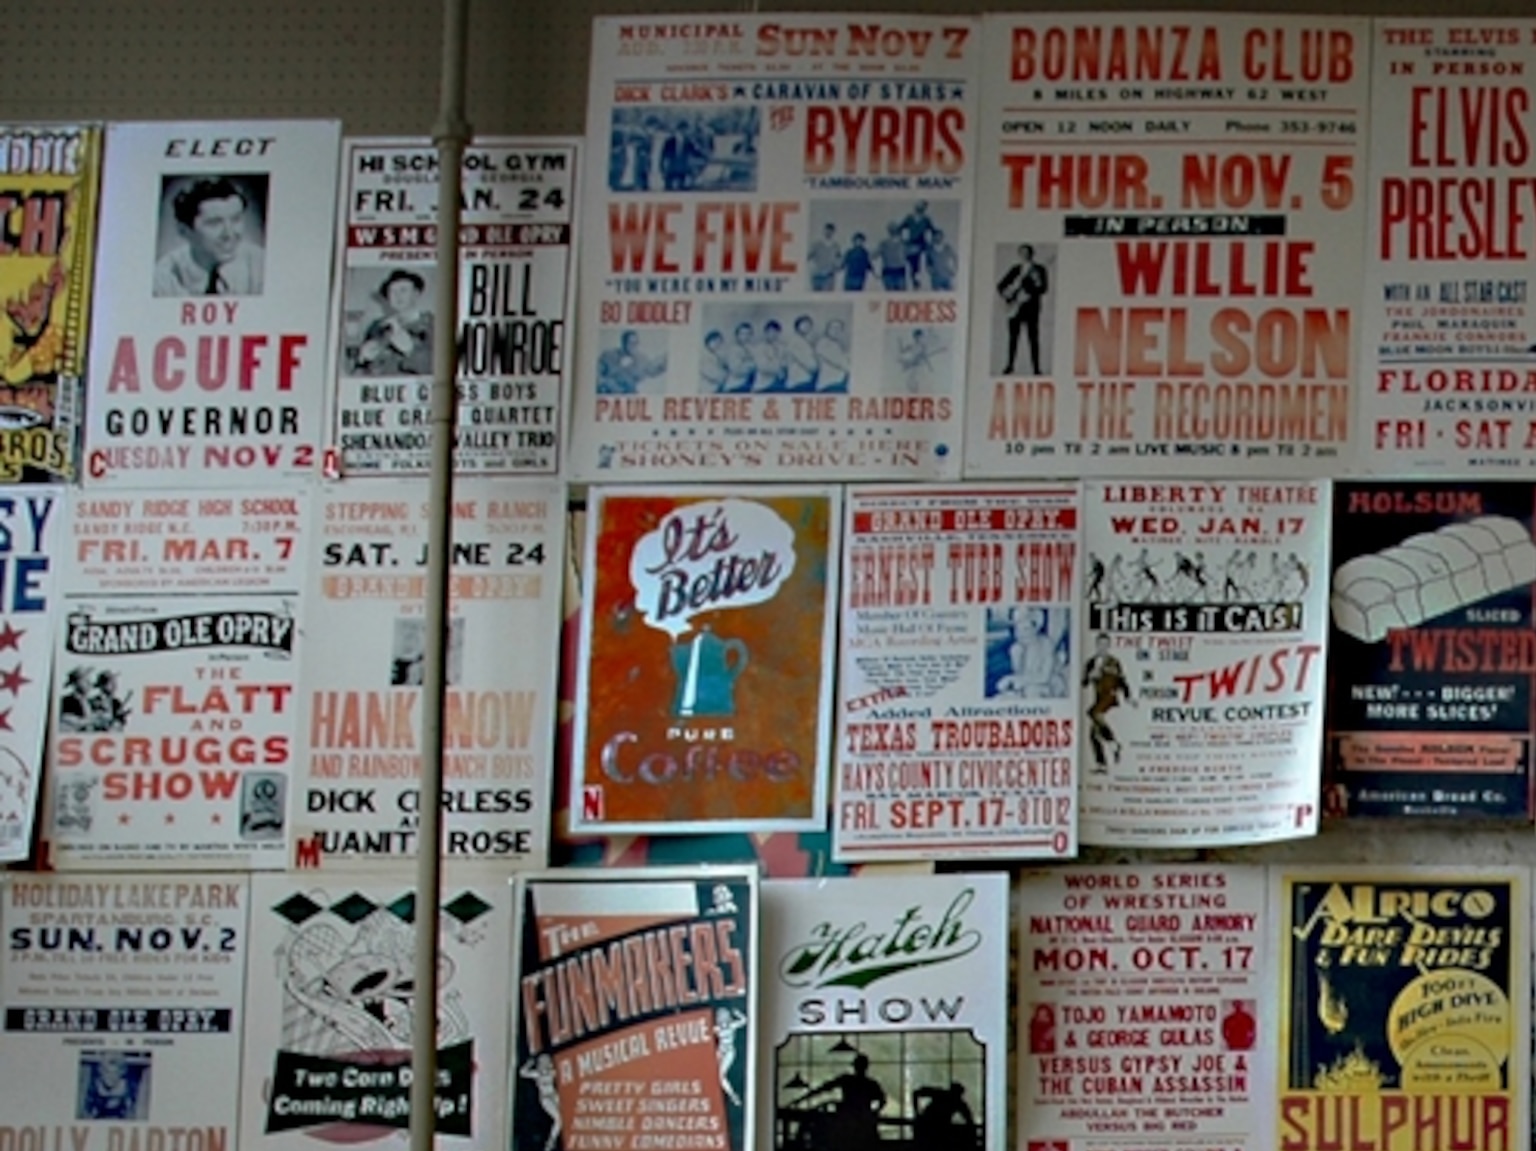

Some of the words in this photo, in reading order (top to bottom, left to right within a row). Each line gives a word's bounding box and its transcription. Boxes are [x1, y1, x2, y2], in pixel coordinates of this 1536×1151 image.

[942, 28, 969, 58] 7
[1384, 29, 1433, 44] THE
[1449, 29, 1520, 44] ELVIS
[1011, 27, 1222, 82] BONANZA
[1243, 28, 1354, 83] CLUB
[752, 83, 840, 100] CARAVAN
[848, 84, 869, 99] OF
[881, 84, 946, 99] STARS
[1055, 90, 1108, 100] MILES
[1120, 89, 1143, 100] ON
[1154, 88, 1236, 100] HIGHWAY
[1247, 89, 1269, 100] 62
[1282, 90, 1328, 100] WEST
[804, 106, 964, 175] BYRDS
[1410, 87, 1530, 168] ELVIS
[164, 138, 276, 157] ELECT
[1002, 154, 1162, 210] THUR.
[1181, 154, 1301, 209] NOV.
[1321, 155, 1354, 210] 5
[608, 203, 682, 273] WE
[694, 203, 800, 273] FIVE
[1116, 242, 1315, 296] WILLIE
[469, 264, 537, 317] BILL
[181, 302, 239, 323] ROY
[1073, 307, 1350, 378] NELSON
[107, 335, 308, 393] ACUFF
[106, 407, 299, 437] GOVERNOR
[1103, 486, 1226, 505] LIBERTY
[1237, 486, 1318, 504] THEATRE
[1348, 492, 1482, 514] HOLSUM
[1110, 515, 1186, 534] WED.
[1199, 515, 1265, 534] JAN.
[1275, 517, 1305, 533] 17
[77, 539, 149, 562] FRI.
[164, 539, 260, 562] MAR.
[277, 539, 294, 559] 7
[645, 507, 739, 574] It's
[657, 550, 784, 622] Better
[1466, 608, 1521, 623] SLICED
[142, 686, 292, 714] FLATT
[310, 692, 418, 749] HANK
[847, 722, 916, 752] TEXAS
[932, 719, 1073, 750] TROUBADORS
[58, 736, 289, 766] SCRUGGS
[102, 772, 240, 800] SHOW
[1064, 874, 1139, 889] WORLD
[1153, 873, 1226, 888] SERIES
[10, 929, 102, 950] SUN.
[115, 929, 210, 950] NOV.
[220, 929, 236, 950] 2
[1034, 947, 1116, 971] MON.
[1132, 947, 1208, 970] OCT.
[1222, 947, 1253, 969] 17
[521, 918, 746, 1055] FUNMAKERS
[800, 997, 965, 1024] SHOW
[1062, 1006, 1108, 1024] TOJO
[1118, 1006, 1217, 1023] YAMAMOTO
[656, 1021, 709, 1053] REVUE
[294, 1068, 338, 1088] Two
[343, 1068, 394, 1088] Corn
